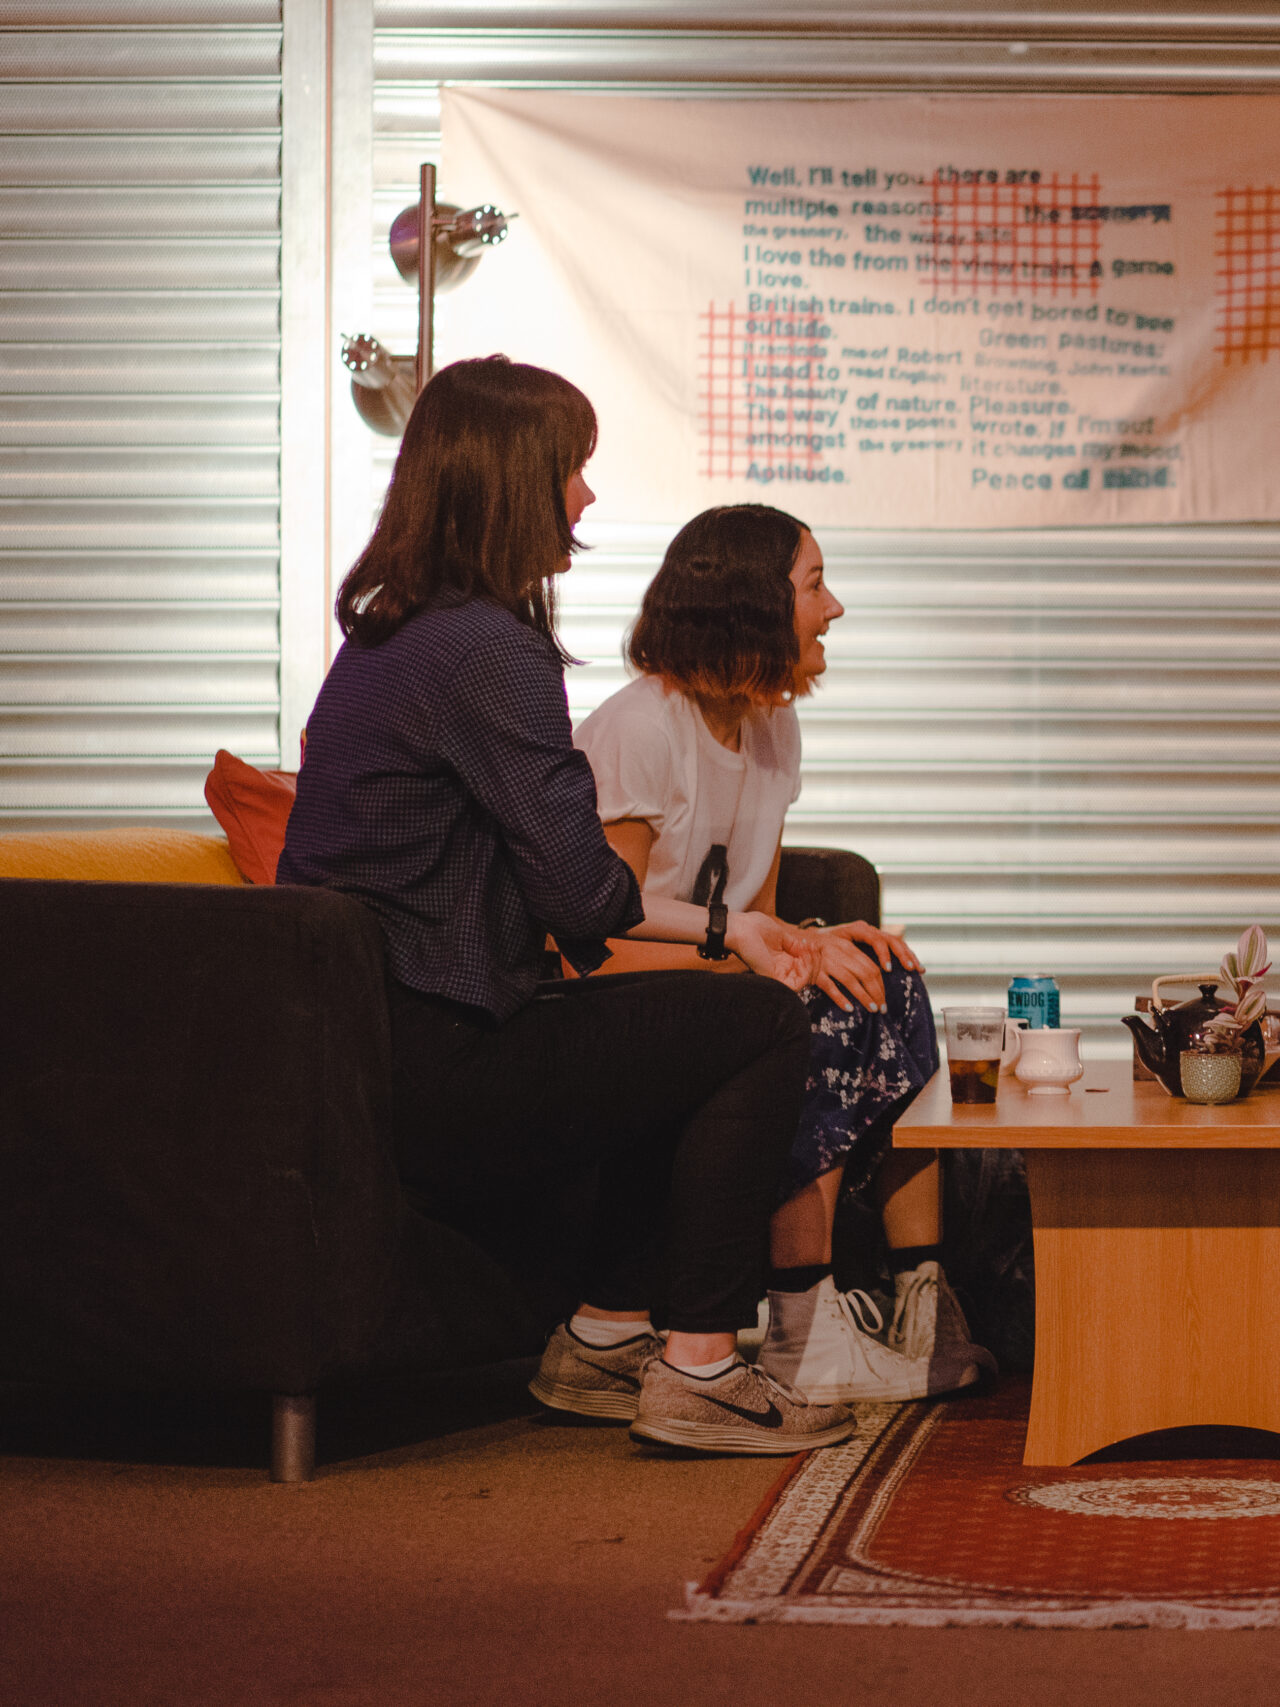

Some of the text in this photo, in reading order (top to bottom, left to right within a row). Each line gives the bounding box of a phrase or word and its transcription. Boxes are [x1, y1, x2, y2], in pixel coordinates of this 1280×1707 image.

[748, 166, 801, 186] Well,
[809, 166, 833, 185] I'll
[842, 168, 876, 187] tell
[937, 165, 998, 184] there
[1006, 169, 1041, 185] are
[745, 197, 839, 221] multiple
[1024, 204, 1060, 224] the
[743, 224, 768, 236] the
[864, 224, 901, 243] the
[744, 245, 749, 262] I
[756, 245, 802, 265] love
[809, 247, 845, 268] the
[853, 250, 908, 271] from
[915, 253, 951, 272] the
[962, 255, 1016, 275] view
[745, 268, 809, 289] I love.
[748, 293, 824, 314] British
[909, 298, 915, 315] I
[923, 296, 979, 316] don't
[987, 299, 1024, 321] get
[1032, 303, 1098, 322] bored
[1106, 307, 1128, 326] to
[745, 318, 838, 340] outside.
[979, 328, 1047, 349] Green
[744, 341, 754, 355] It
[760, 342, 828, 358] reminds
[842, 347, 869, 359] me
[871, 347, 888, 359] of
[897, 347, 962, 364] Robert
[743, 359, 748, 377] I
[755, 361, 811, 380] used
[817, 364, 840, 381] to
[849, 366, 884, 379] read
[744, 383, 1075, 415] The beauty of nature. Pleasure.
[744, 403, 786, 422] The
[794, 407, 839, 427] way
[850, 416, 900, 430] those
[906, 418, 957, 432] poets
[1117, 416, 1155, 434] out
[745, 432, 846, 453] amongst
[859, 439, 885, 452] the
[972, 439, 986, 456] it
[993, 442, 1076, 461] changes
[745, 462, 850, 484] Aptitude.
[971, 468, 1052, 490] Peace
[1062, 468, 1090, 490] of
